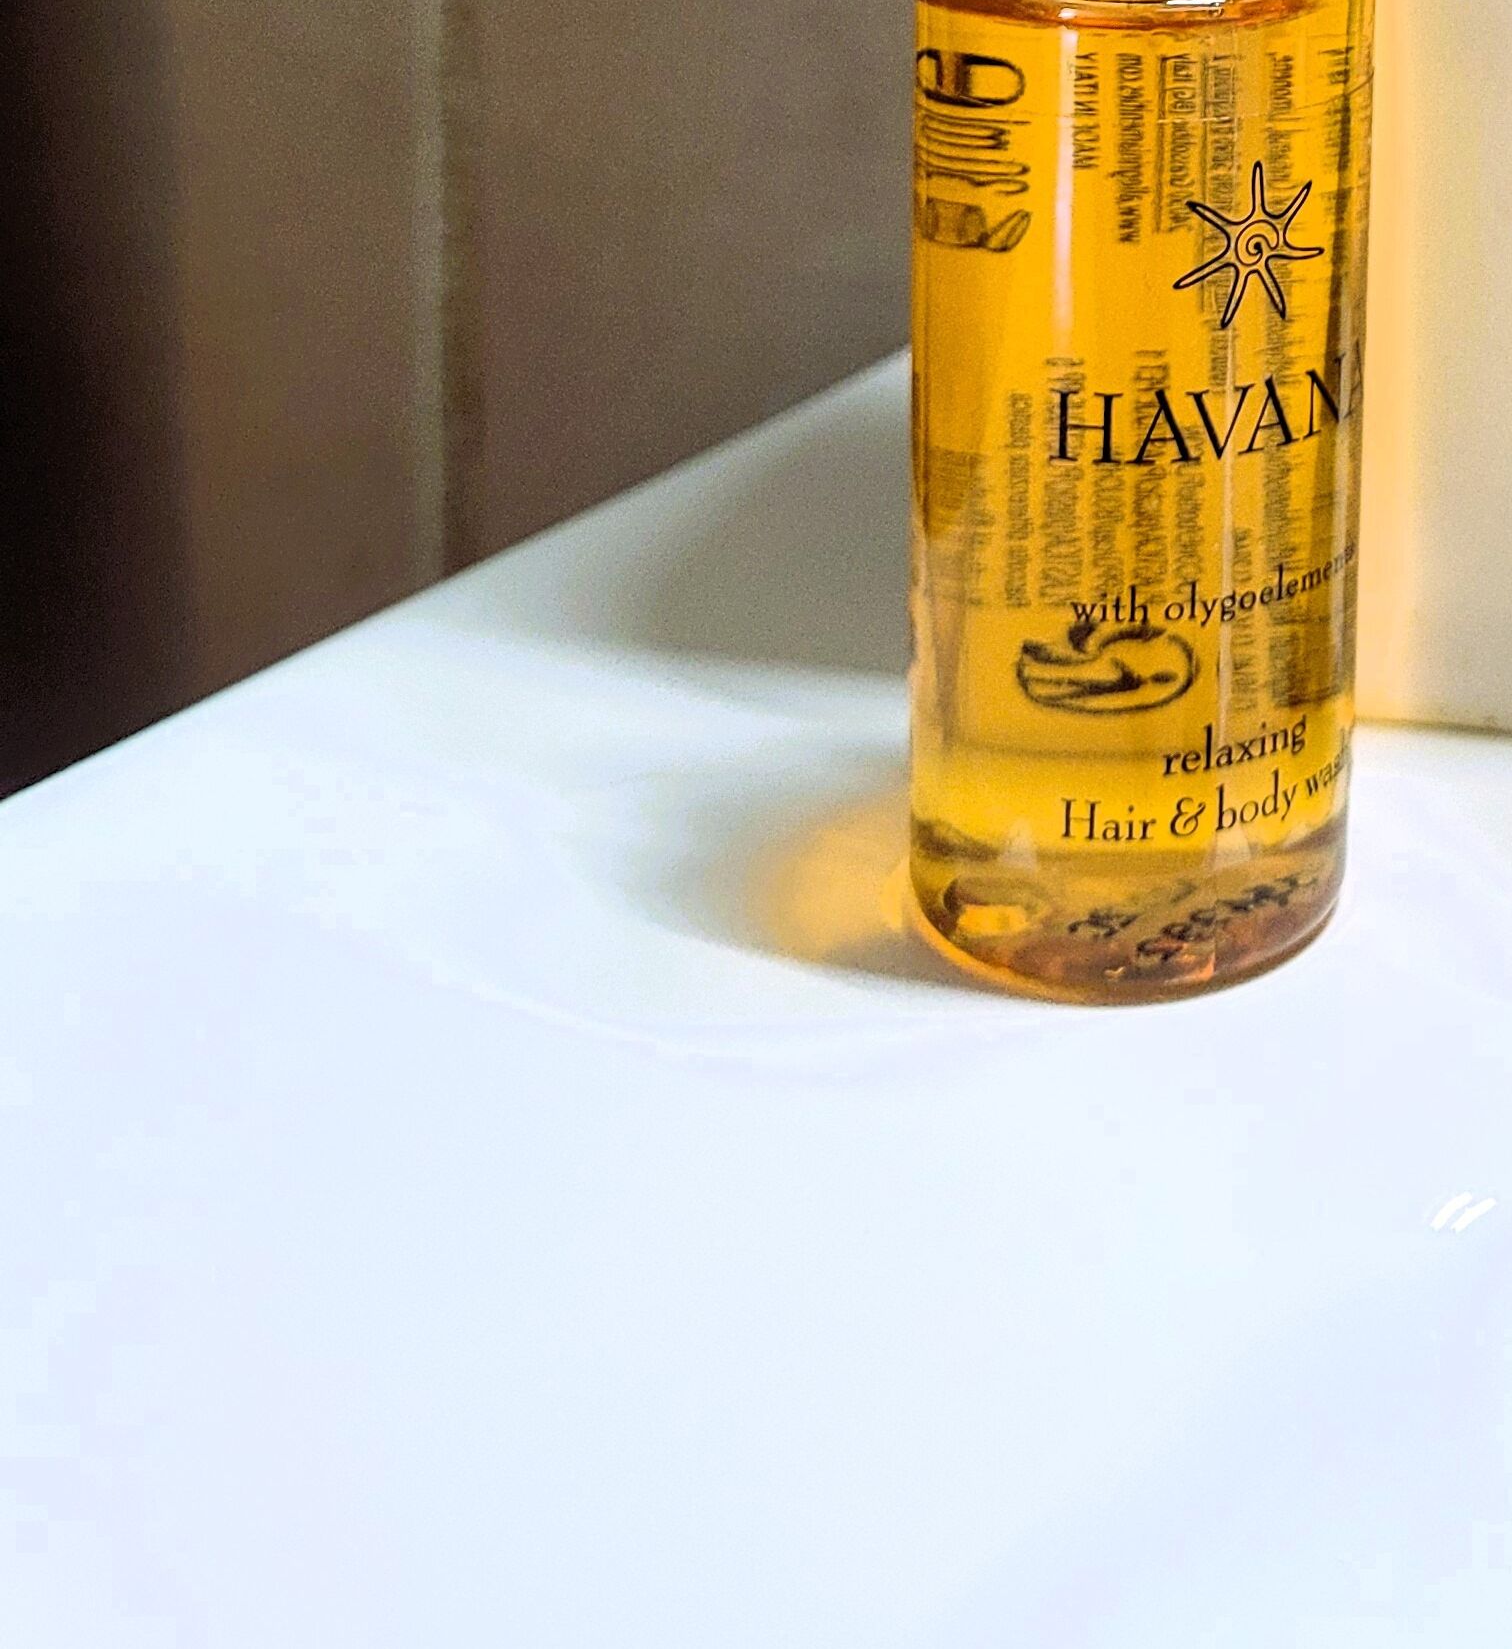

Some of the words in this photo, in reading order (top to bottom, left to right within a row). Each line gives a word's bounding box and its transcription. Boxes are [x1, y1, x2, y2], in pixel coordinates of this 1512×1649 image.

[1049, 338, 1365, 464] HAVANA
[1070, 583, 1150, 623] with
[1163, 542, 1356, 627] olygoelemen
[1162, 714, 1307, 778] relaxing
[1061, 797, 1157, 842] Hair
[1169, 797, 1206, 838] &
[1215, 766, 1298, 832] body
